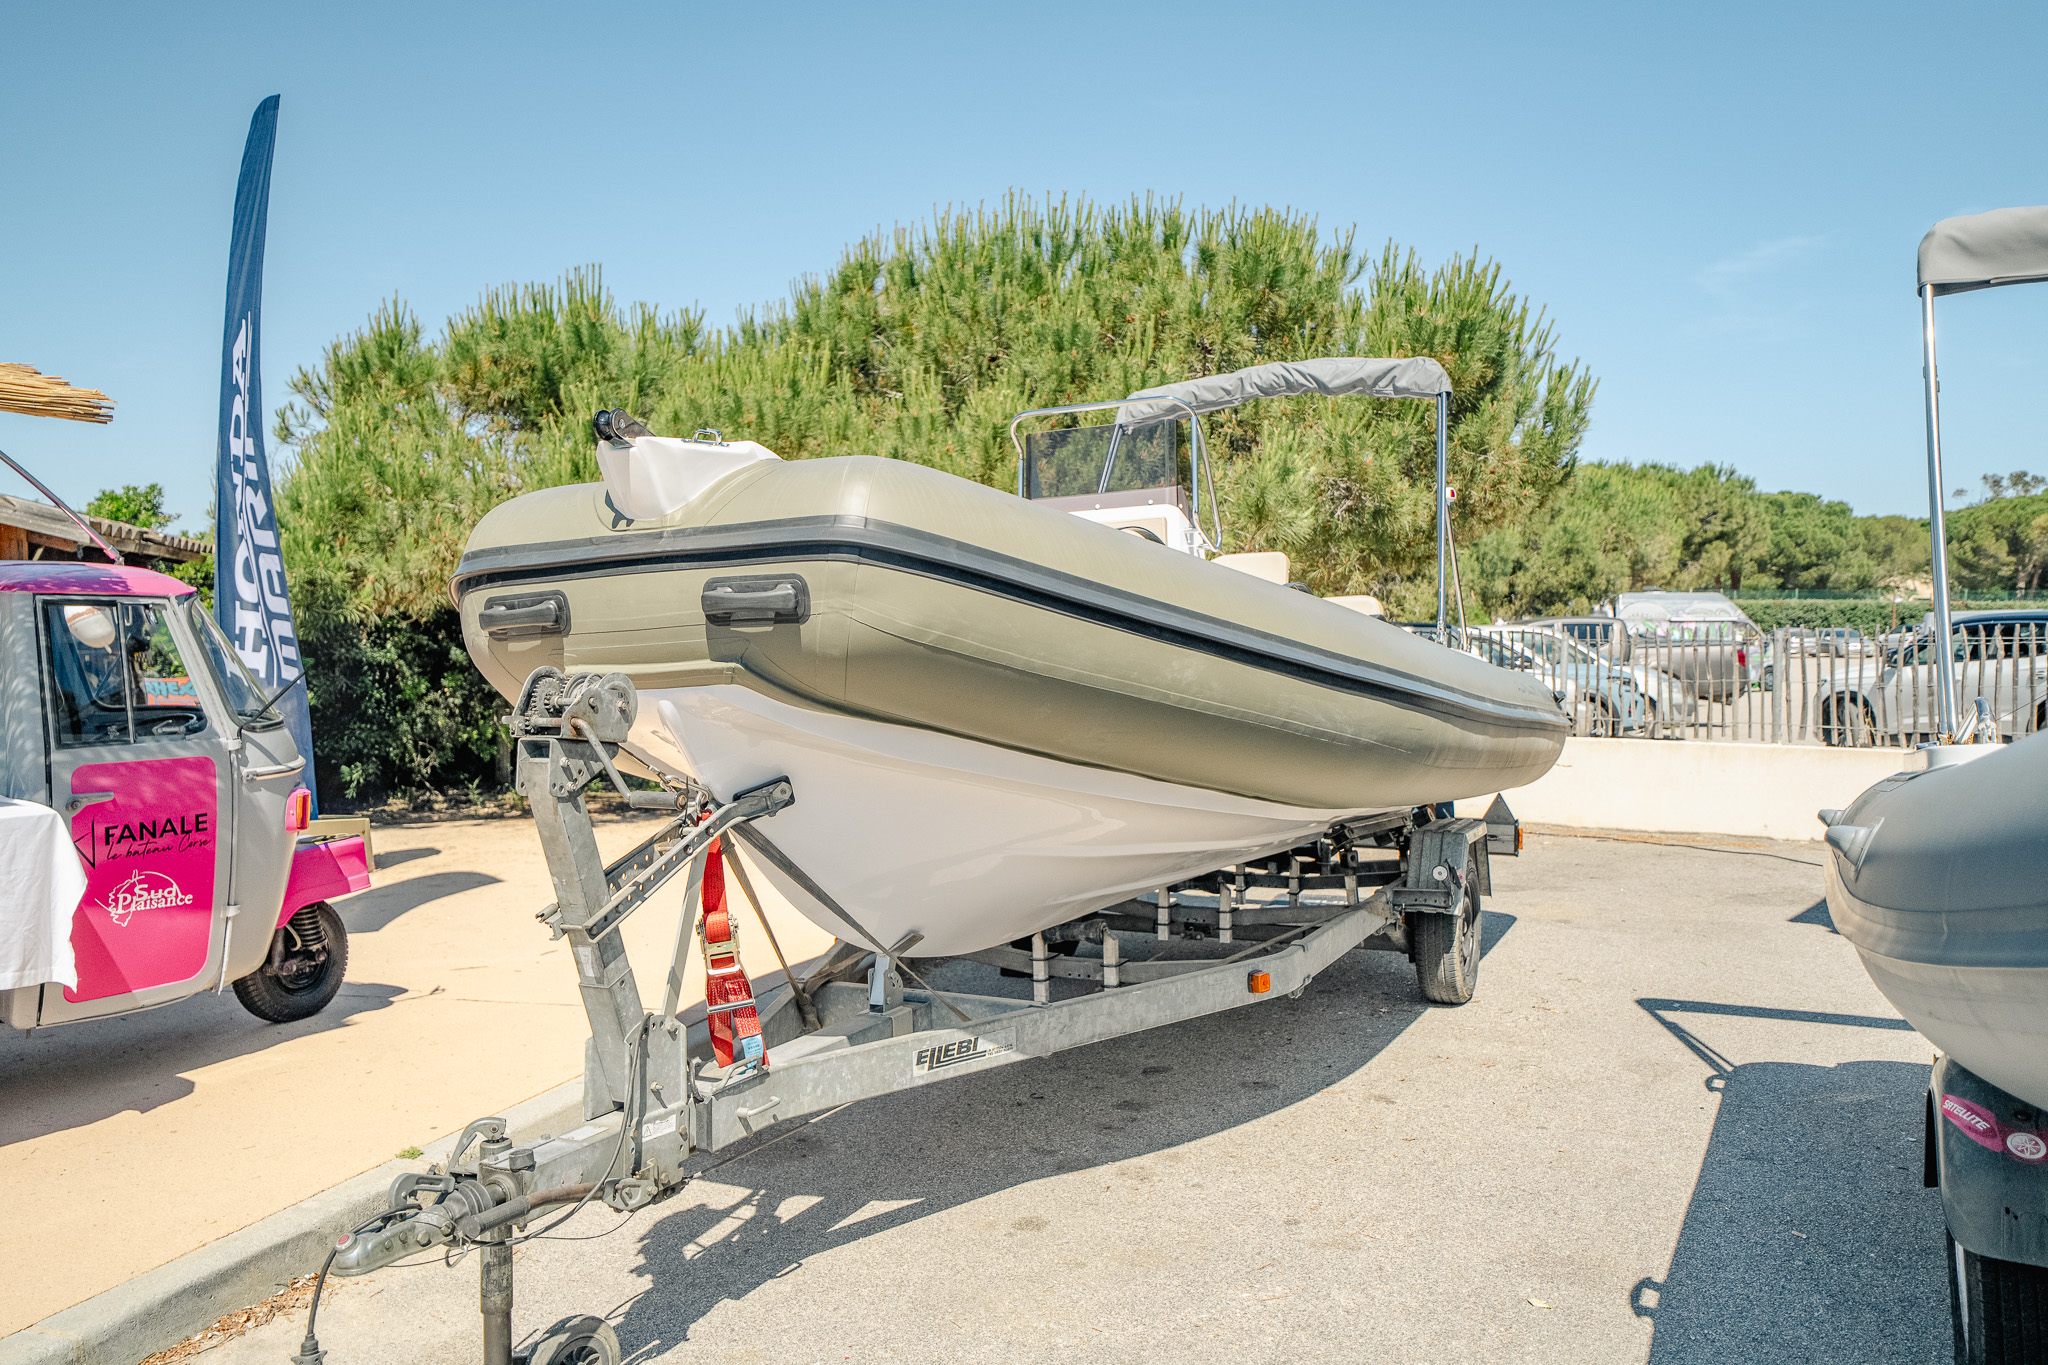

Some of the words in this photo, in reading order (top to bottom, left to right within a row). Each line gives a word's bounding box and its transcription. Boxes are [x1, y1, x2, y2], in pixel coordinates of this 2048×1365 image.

[229, 318, 268, 678] HONDA
[104, 812, 208, 846] FANALE
[126, 838, 173, 860] bateau
[117, 892, 193, 915] Plaisance
[133, 884, 178, 901] Sud
[915, 1036, 979, 1072] ELLEBI
[1942, 1099, 1991, 1131] SATELLITE
